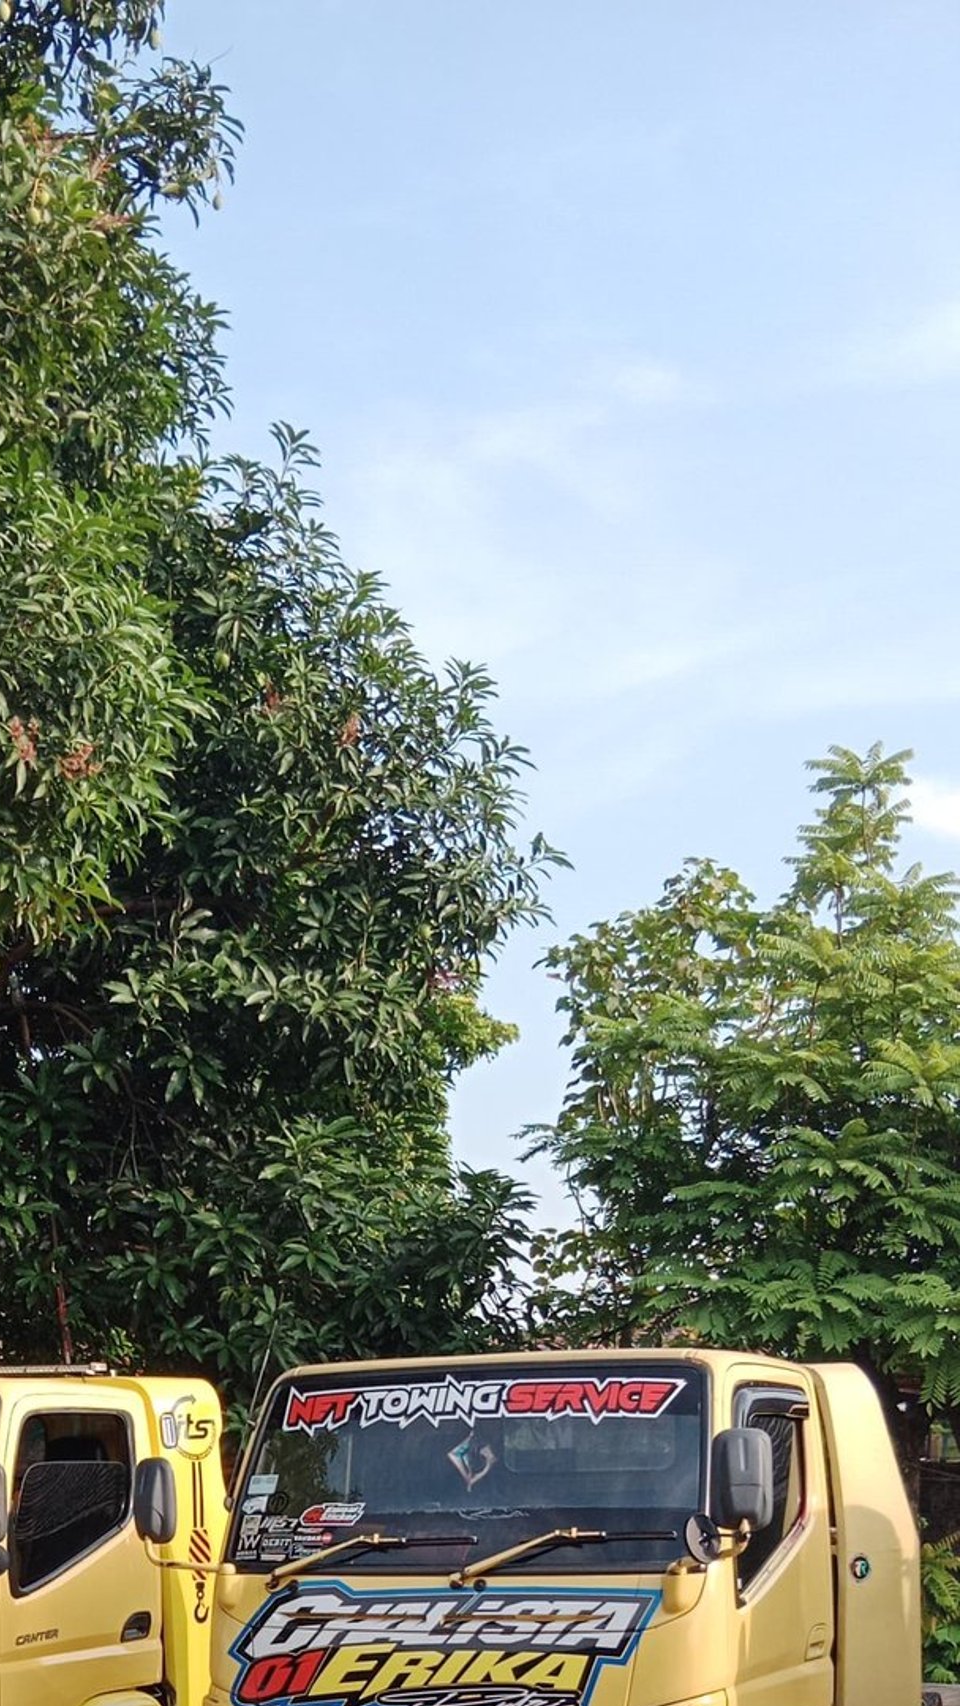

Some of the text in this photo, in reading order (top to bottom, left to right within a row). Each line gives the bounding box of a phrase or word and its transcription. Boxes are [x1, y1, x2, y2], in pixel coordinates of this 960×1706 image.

[287, 1381, 677, 1425] NET TOWING SERVICE
[15, 1628, 60, 1646] CANTER
[240, 1643, 586, 1700] 01 ERIKA
